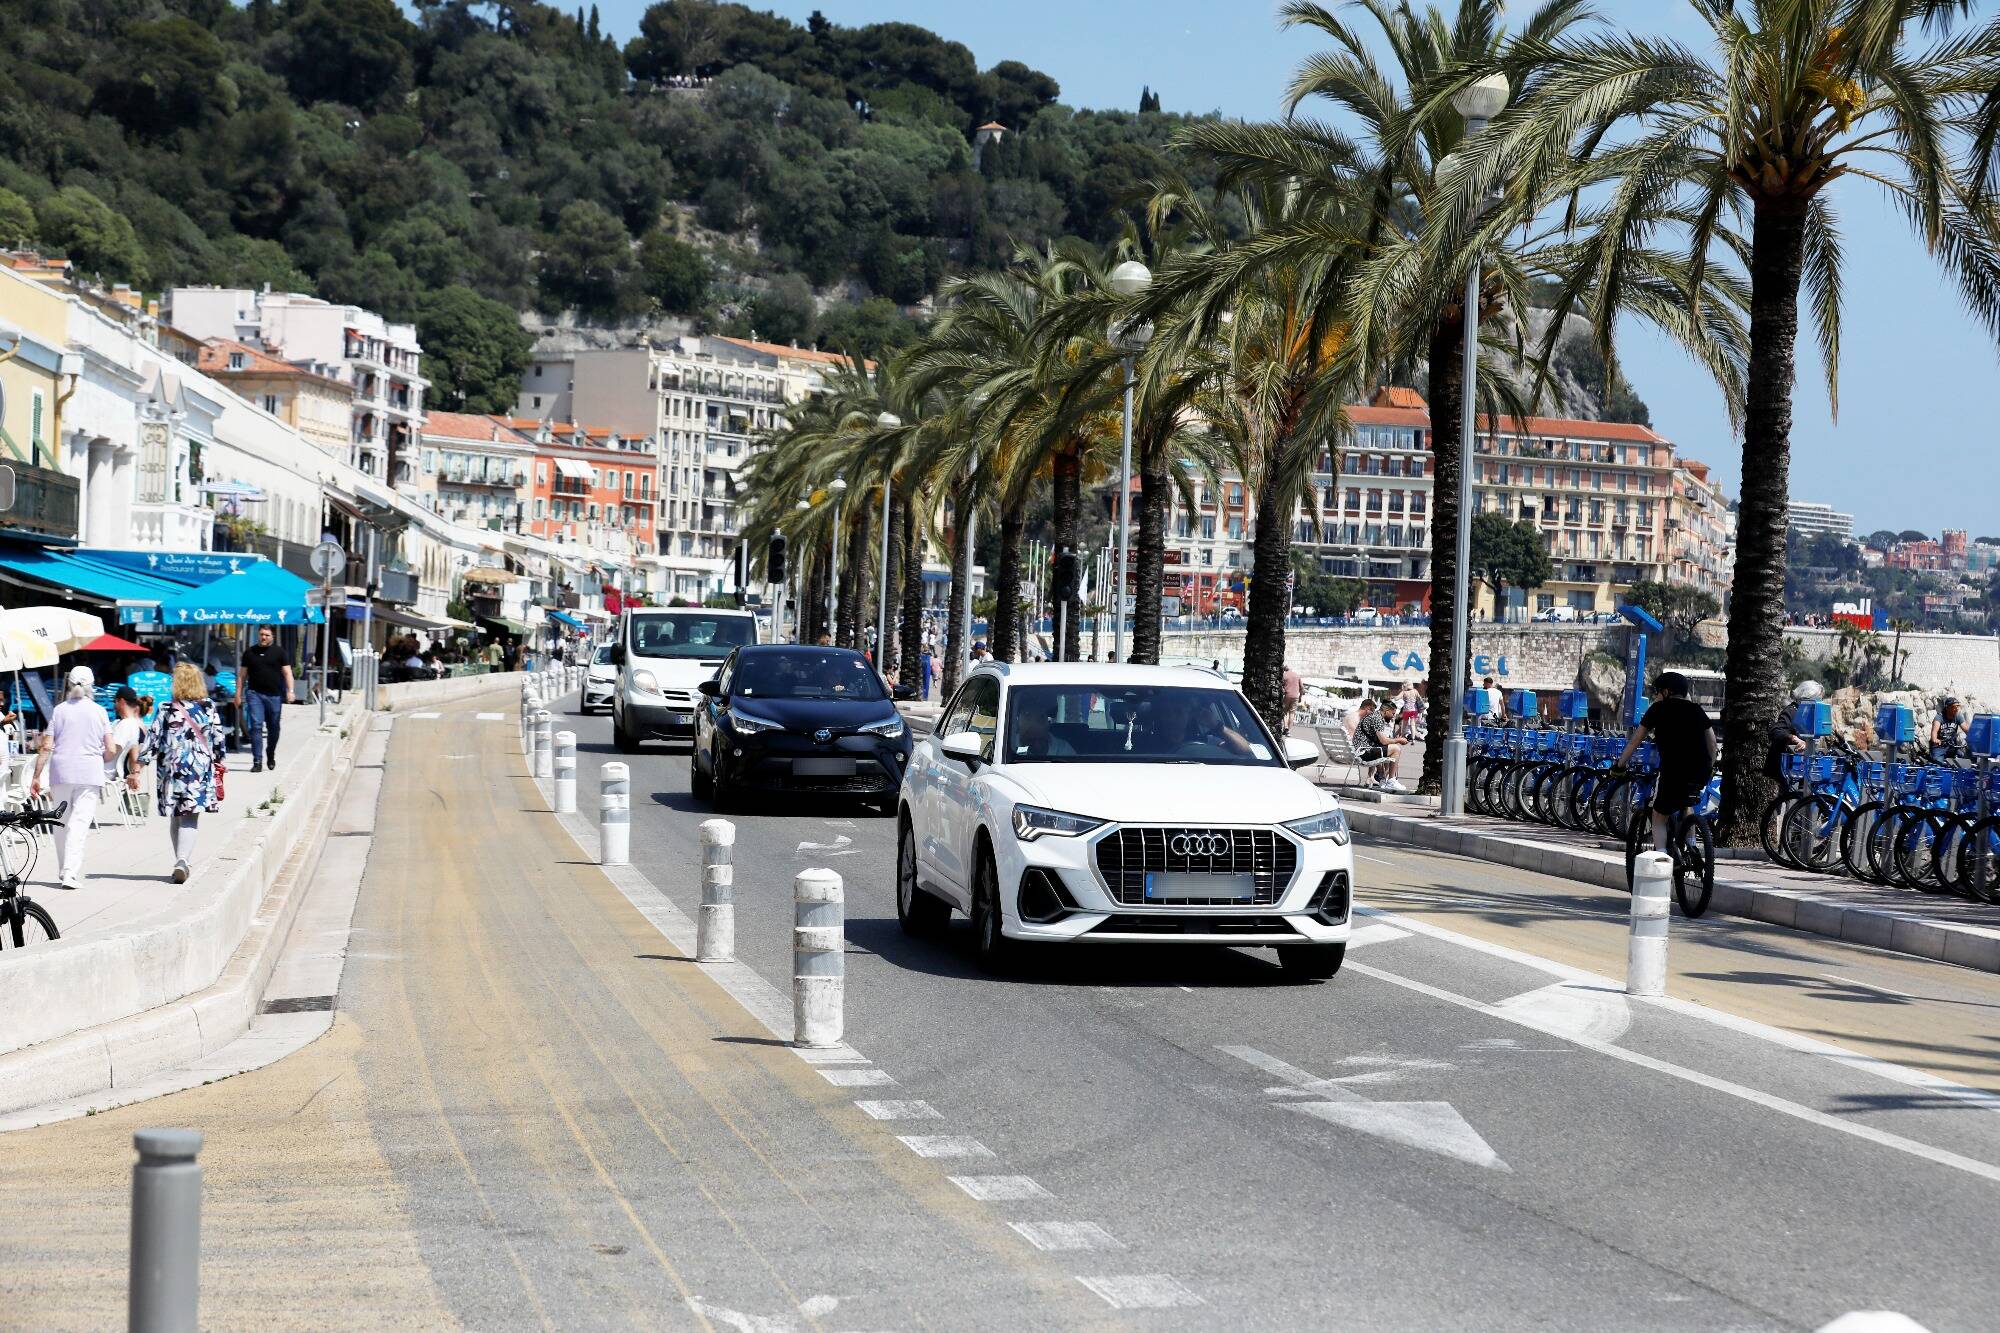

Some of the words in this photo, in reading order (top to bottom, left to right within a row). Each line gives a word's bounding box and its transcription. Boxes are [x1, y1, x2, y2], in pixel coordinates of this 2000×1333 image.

[165, 554, 184, 564] Quai
[185, 556, 195, 564] des
[198, 556, 223, 566] Anges
[194, 608, 218, 621] Quai
[219, 609, 234, 620] des
[236, 608, 271, 621] Anges
